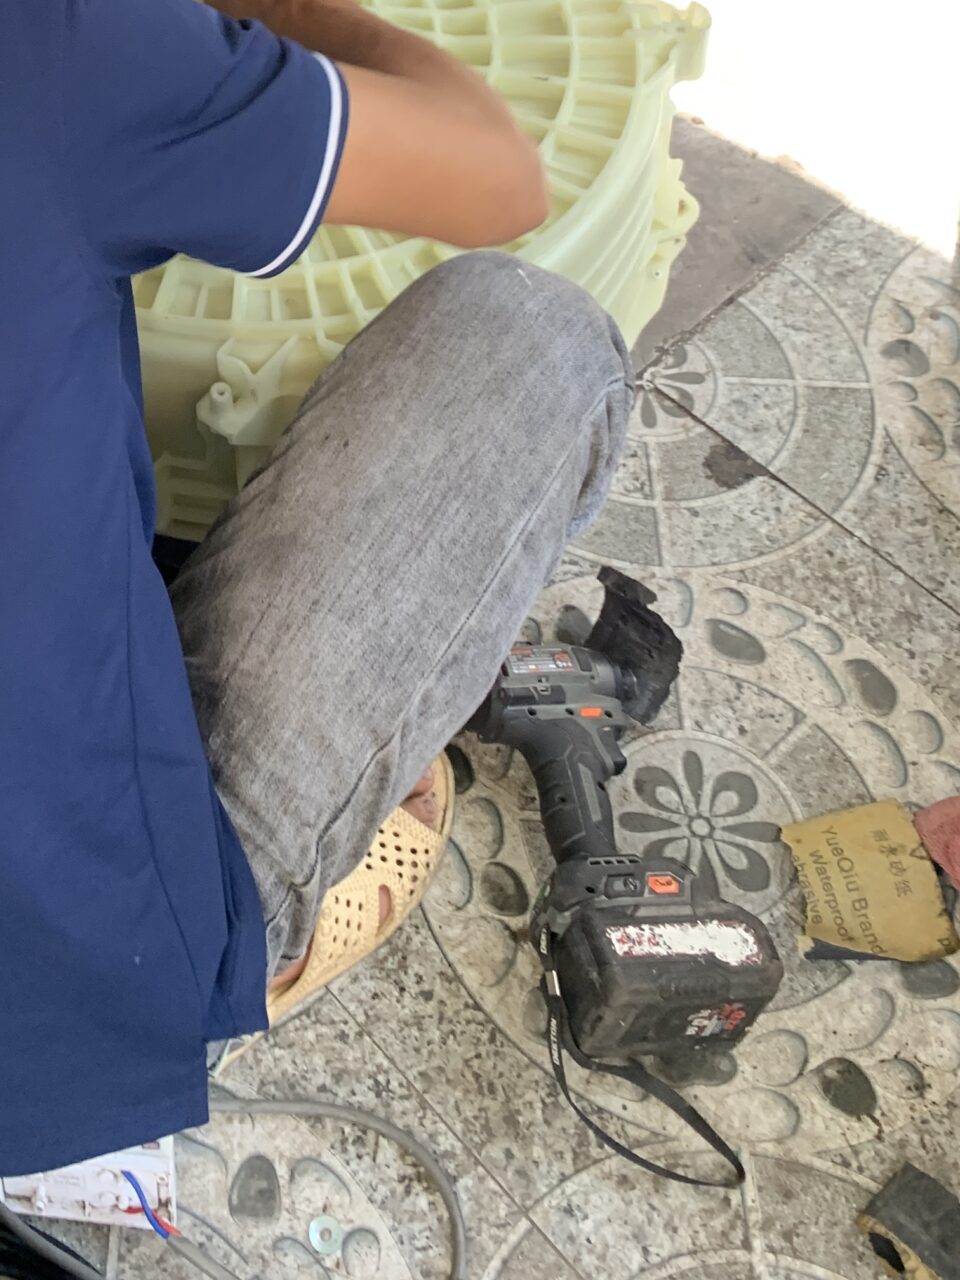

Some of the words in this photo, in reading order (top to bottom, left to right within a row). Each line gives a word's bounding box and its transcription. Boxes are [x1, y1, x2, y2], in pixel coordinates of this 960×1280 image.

[808, 849, 856, 942] Waterproof
[820, 825, 860, 893] YueQiu
[851, 896, 889, 954] Brand
